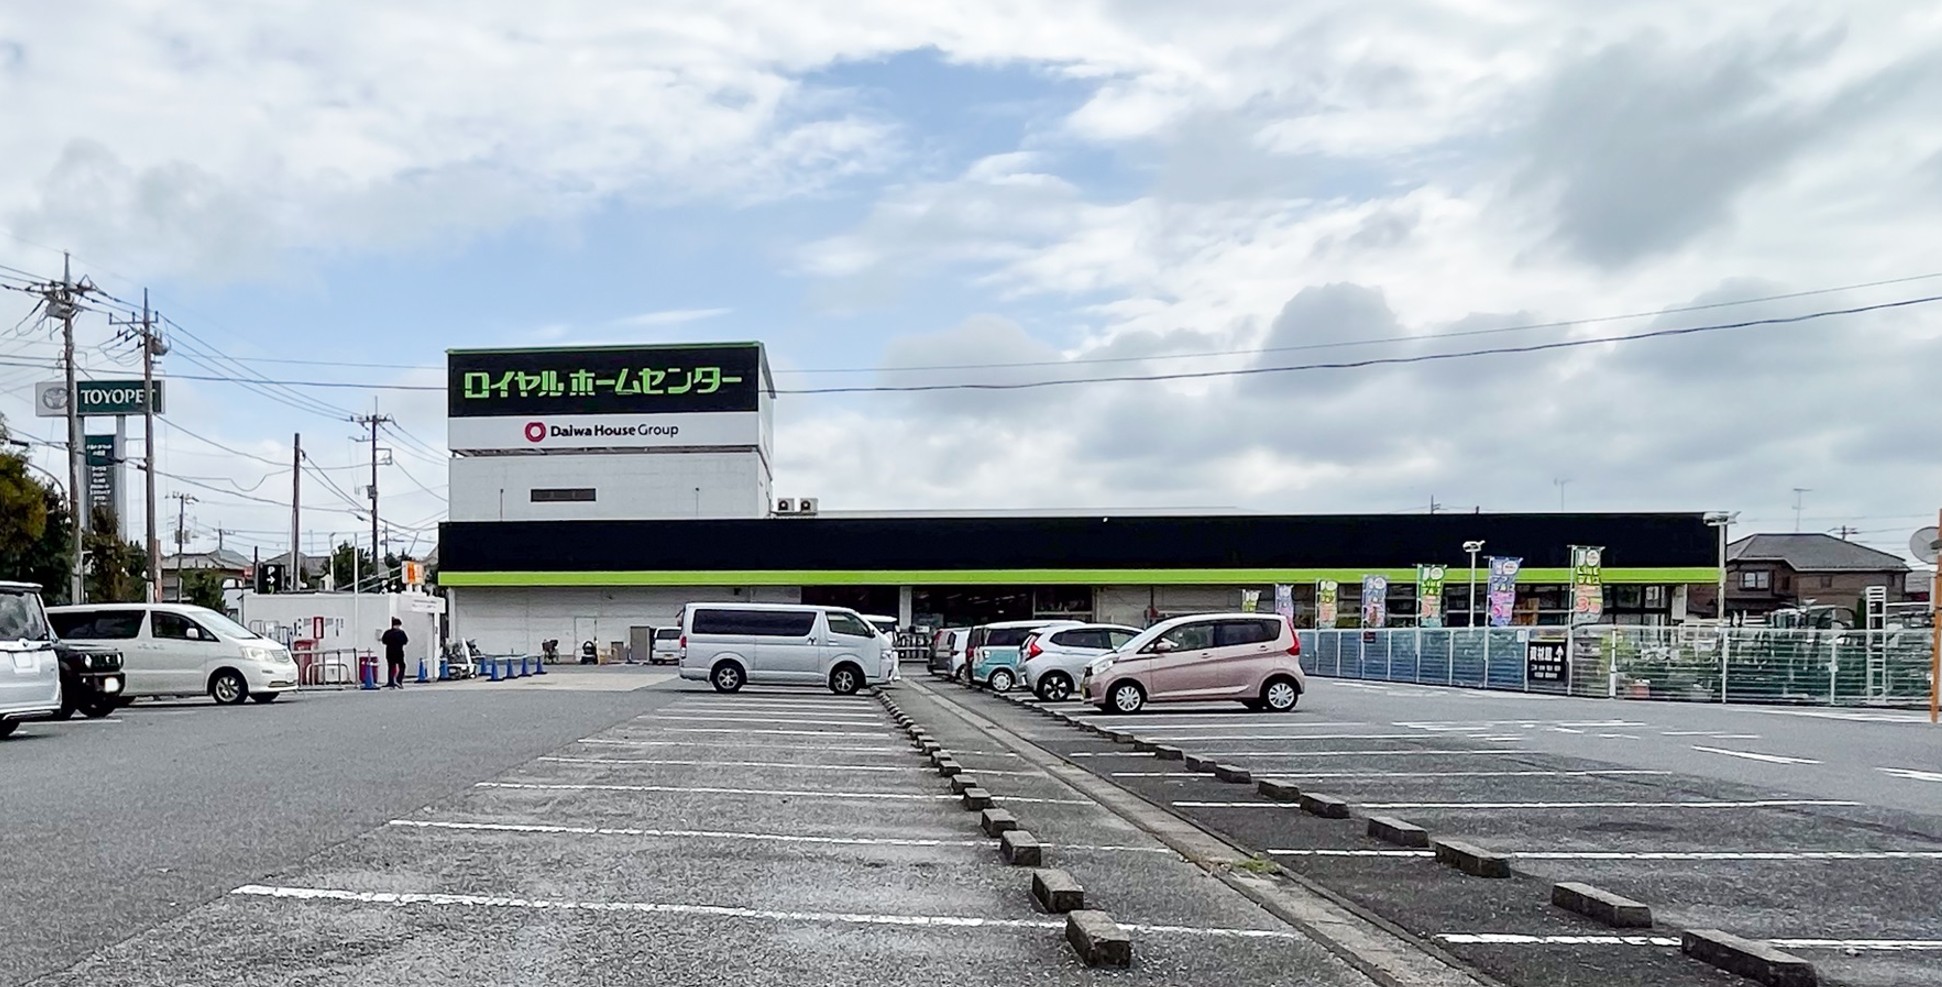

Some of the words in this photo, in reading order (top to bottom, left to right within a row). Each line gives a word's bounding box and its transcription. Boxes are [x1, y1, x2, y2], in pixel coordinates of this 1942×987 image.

[80, 388, 156, 405] TOYOPE
[550, 424, 592, 437] Daiwa
[594, 424, 636, 436] House
[638, 423, 679, 437] Group
